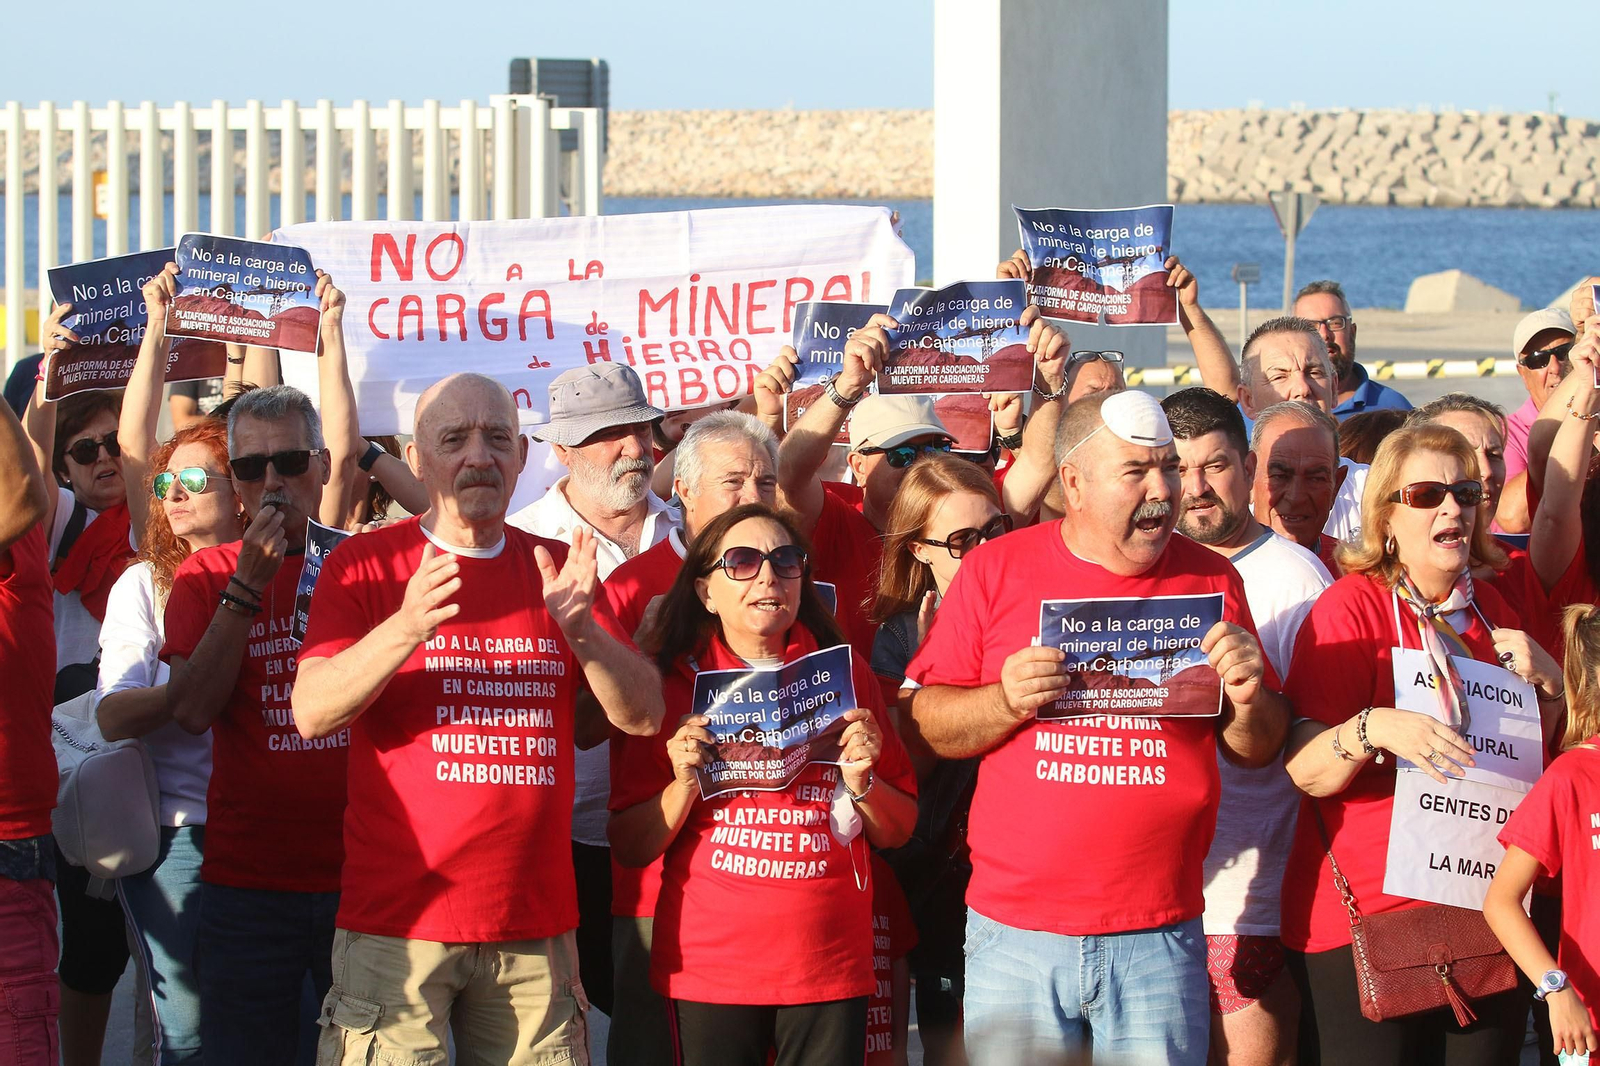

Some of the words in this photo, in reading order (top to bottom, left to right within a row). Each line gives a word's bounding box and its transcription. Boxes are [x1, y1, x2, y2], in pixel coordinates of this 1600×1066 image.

[1032, 221, 1054, 232] No
[1058, 224, 1066, 233] a
[1070, 224, 1082, 238] la
[1086, 228, 1130, 243] carga
[1134, 223, 1154, 236] de
[370, 232, 464, 282] NO
[506, 263, 523, 282] A
[568, 258, 604, 280] LA
[1038, 235, 1086, 254] mineral
[1090, 245, 1107, 258] de
[1112, 244, 1156, 257] hierro
[192, 248, 212, 262] No
[216, 254, 224, 264] a
[229, 252, 241, 266] la
[245, 258, 285, 274] carga
[288, 261, 307, 274] de
[1044, 256, 1060, 268] en
[1065, 256, 1150, 277] Carboneras
[72, 283, 97, 302] No
[102, 284, 113, 296] a
[116, 277, 132, 294] la
[188, 267, 240, 284] mineral
[244, 274, 261, 287] de
[265, 276, 306, 292] hierro
[193, 286, 210, 297] en
[213, 287, 297, 307] Carboneras
[1026, 284, 1068, 300] PLATAFORMA
[1069, 290, 1080, 300] DE
[1080, 291, 1132, 304] ASOCIACIONES
[1030, 294, 1060, 309] MUEVETE
[1060, 300, 1076, 310] POR
[1077, 302, 1128, 315] CARBONERAS
[76, 300, 132, 326] mineral
[368, 289, 555, 342] CARGA
[585, 311, 609, 336] de
[902, 301, 922, 316] No
[926, 306, 934, 316] a
[936, 301, 945, 313] la
[948, 298, 990, 312] carga
[994, 296, 1012, 310] de
[175, 310, 218, 324] PLATAFORMA
[218, 314, 228, 324] DE
[228, 316, 276, 330] ASOCIACIONES
[180, 320, 211, 332] MUEVETE
[211, 324, 226, 334] POR
[226, 325, 270, 338] CARBONERAS
[897, 318, 944, 334] mineral
[948, 316, 966, 330] de
[971, 314, 1014, 329] hierro
[80, 332, 101, 345] en
[107, 323, 146, 344] Carb
[814, 322, 840, 340] No
[900, 338, 916, 350] en
[922, 336, 1008, 350] Carboneras
[58, 360, 108, 377] PLATAFORMA
[109, 360, 121, 370] DE
[528, 355, 551, 370] de
[885, 365, 929, 376] PLATAFORMA
[930, 365, 940, 374] DE
[940, 364, 990, 374] ASOCIACIONES
[62, 370, 99, 386] MUEVETE
[100, 369, 116, 380] POR
[892, 375, 924, 385] MUEVETE
[924, 375, 938, 384] POR
[938, 374, 985, 384] CARBONERAS
[512, 388, 532, 409] n
[310, 539, 320, 556] No
[1061, 618, 1086, 633] No
[1091, 620, 1102, 632] a
[1108, 617, 1122, 632] la
[1127, 618, 1174, 634] carga
[1180, 614, 1200, 628] de
[249, 638, 300, 657] MINERA
[425, 635, 446, 650] NO
[450, 636, 460, 650] A
[464, 636, 480, 652] LA
[485, 638, 534, 654] CARGA
[538, 638, 560, 654] DEL
[1060, 638, 1121, 653] mineral
[1126, 638, 1148, 652] de
[1153, 636, 1201, 650] hierro
[266, 659, 282, 674] EN
[425, 656, 490, 674] MINERAL
[494, 660, 512, 675] DE
[518, 660, 565, 676] HIERRO
[1067, 661, 1088, 672] en
[1094, 656, 1192, 672] Carboneras
[443, 678, 462, 694] EN
[467, 680, 556, 698] CARBONERAS
[708, 688, 728, 704] No
[733, 692, 744, 704] a
[749, 688, 764, 703] la
[768, 678, 809, 702] carga
[812, 670, 831, 684] de
[1100, 688, 1111, 700] DE
[1112, 688, 1169, 700] ASOCIACIONES
[1414, 671, 1522, 708] ASIACION
[772, 706, 790, 722] de
[794, 690, 835, 714] hierro
[1055, 700, 1091, 710] MUEVETE
[1092, 700, 1110, 710] POR
[1110, 698, 1163, 710] CARBONERAS
[436, 706, 554, 728] PLATAFORMA
[716, 732, 736, 744] en
[741, 714, 832, 744] Carboneras
[432, 734, 520, 756] MUEVETE
[526, 737, 557, 756] POR
[1035, 731, 1122, 756] MUEVETE
[1130, 738, 1167, 758] POR
[436, 760, 556, 786] CARBONERAS
[703, 760, 752, 774] PLATAFORMA
[754, 760, 765, 770] DE
[712, 771, 748, 783] MUEVETE
[748, 771, 765, 780] POR
[1036, 759, 1166, 785] CARBONERAS
[1419, 792, 1491, 822] GENTES
[710, 827, 792, 852] MUEVETE
[800, 833, 830, 852] POR
[711, 849, 828, 880] CARBONERAS
[1428, 852, 1452, 872] LA
[1458, 858, 1496, 880] MAR
